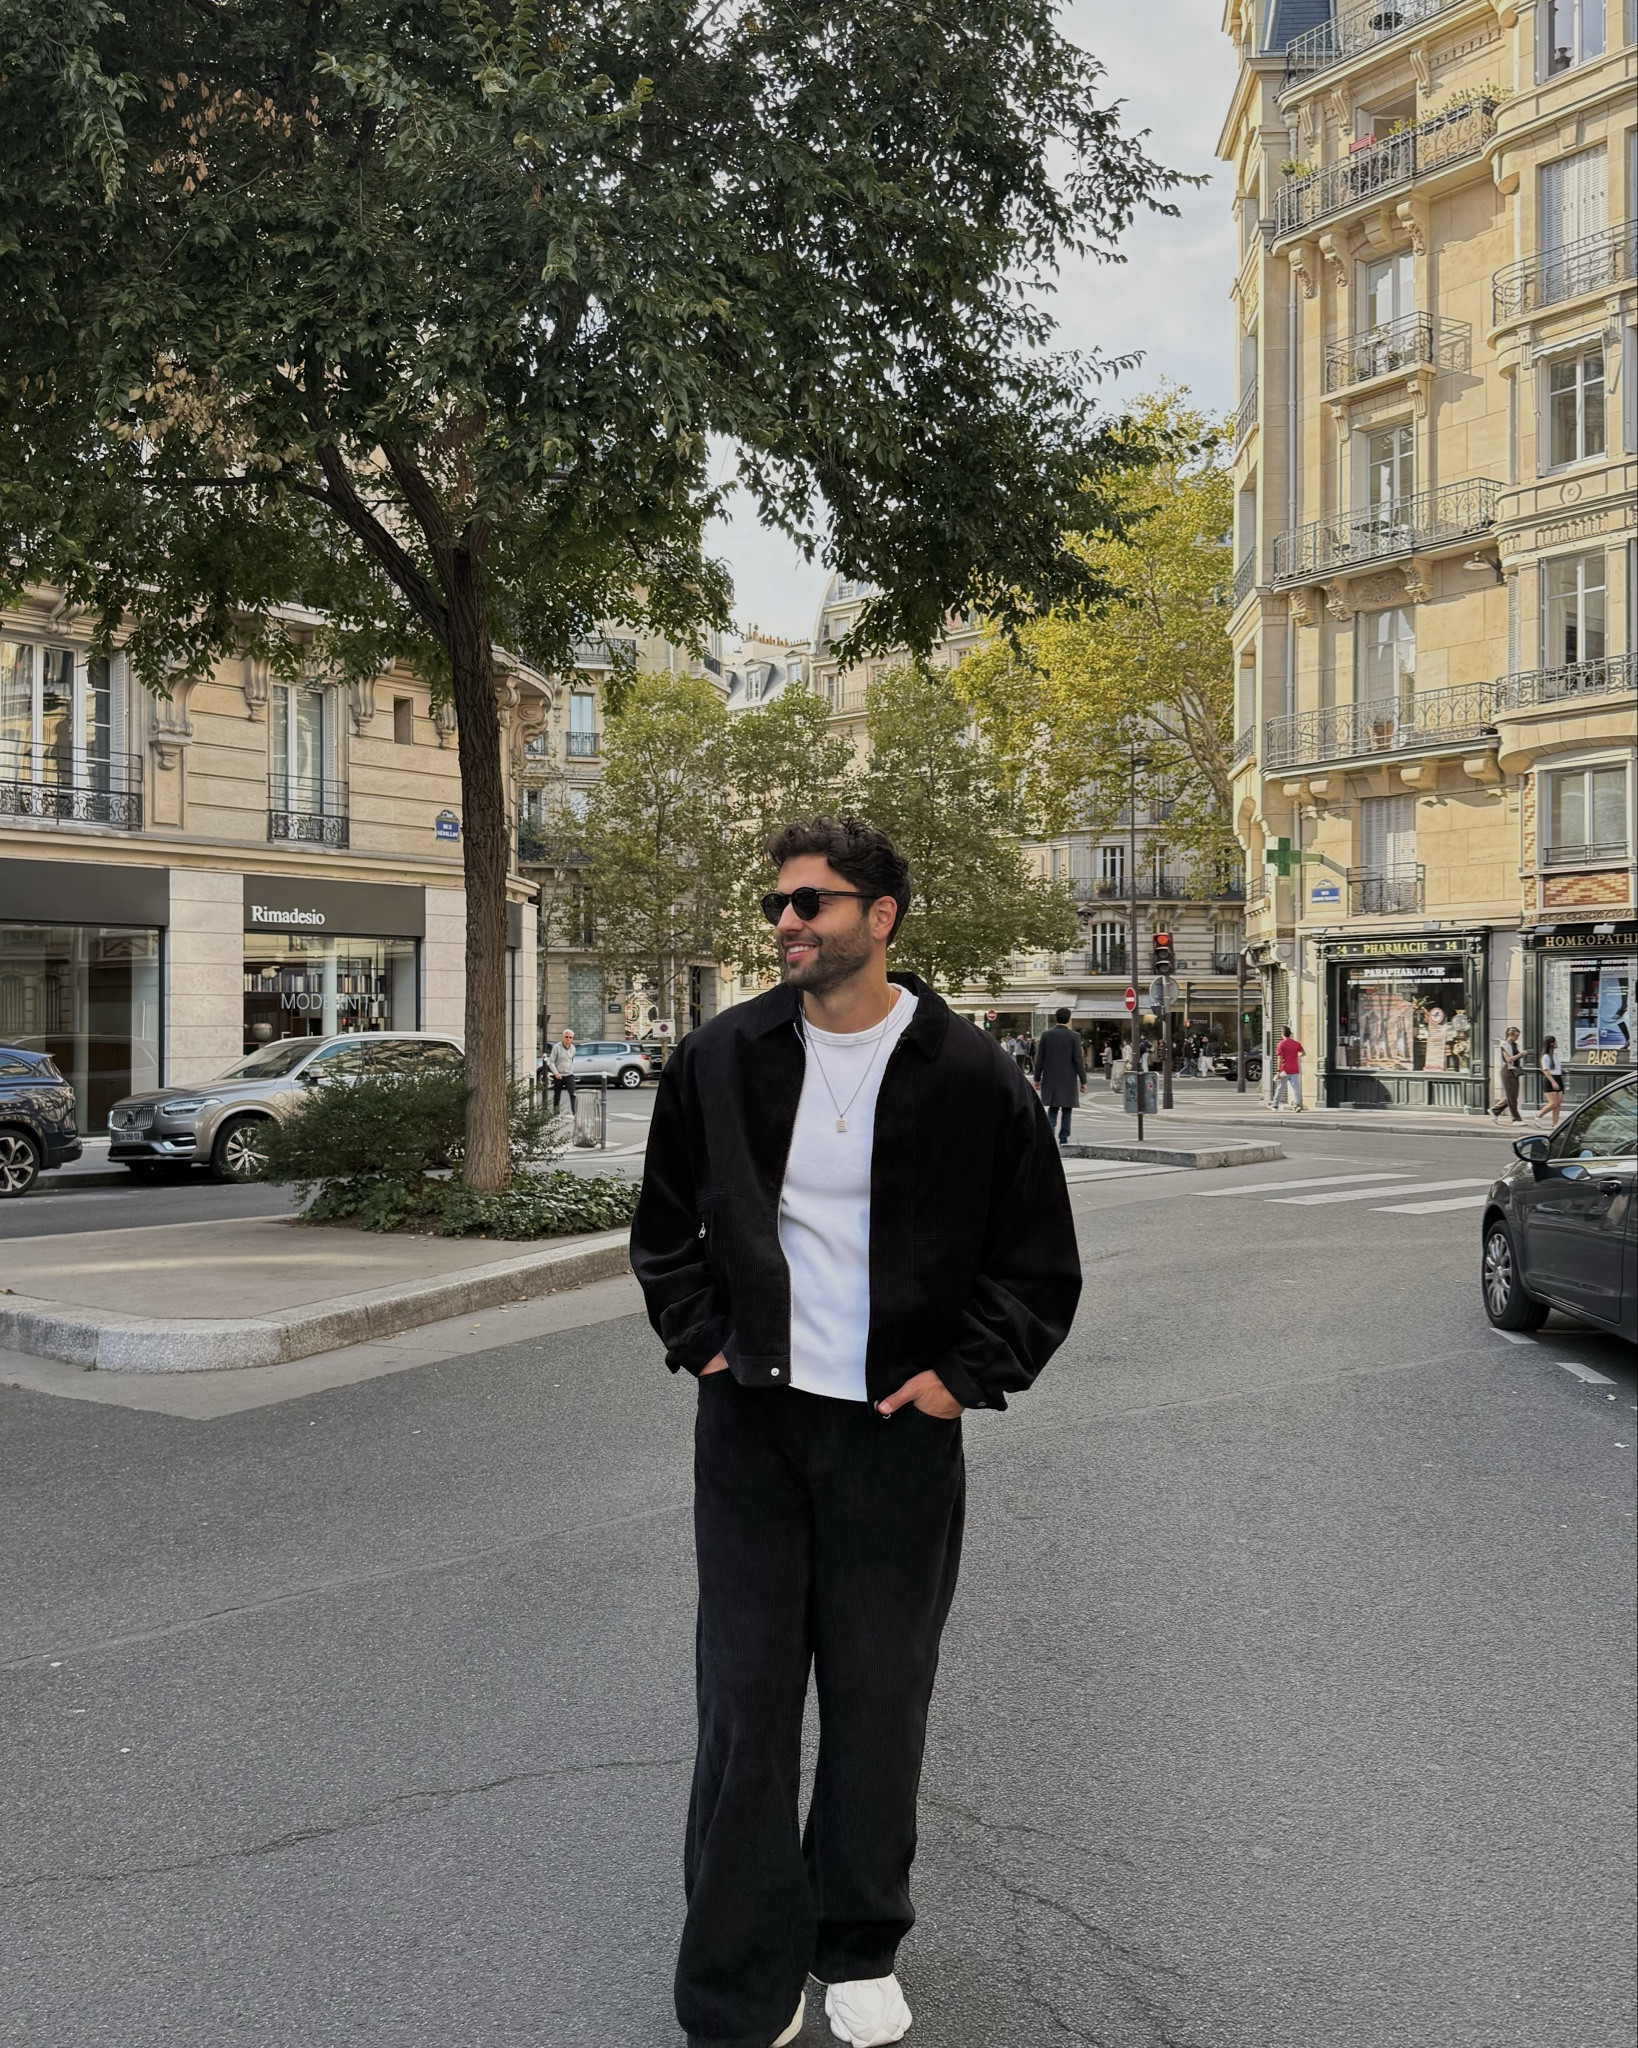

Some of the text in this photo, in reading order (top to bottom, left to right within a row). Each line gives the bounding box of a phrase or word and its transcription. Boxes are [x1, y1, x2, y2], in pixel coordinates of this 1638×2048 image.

[250, 905, 326, 925] Rimadesio
[1363, 942, 1429, 954] PHARMACIE
[1445, 941, 1458, 951] 14
[1363, 967, 1446, 978] PARAPHARMACIE
[1588, 1050, 1618, 1066] PARIS
